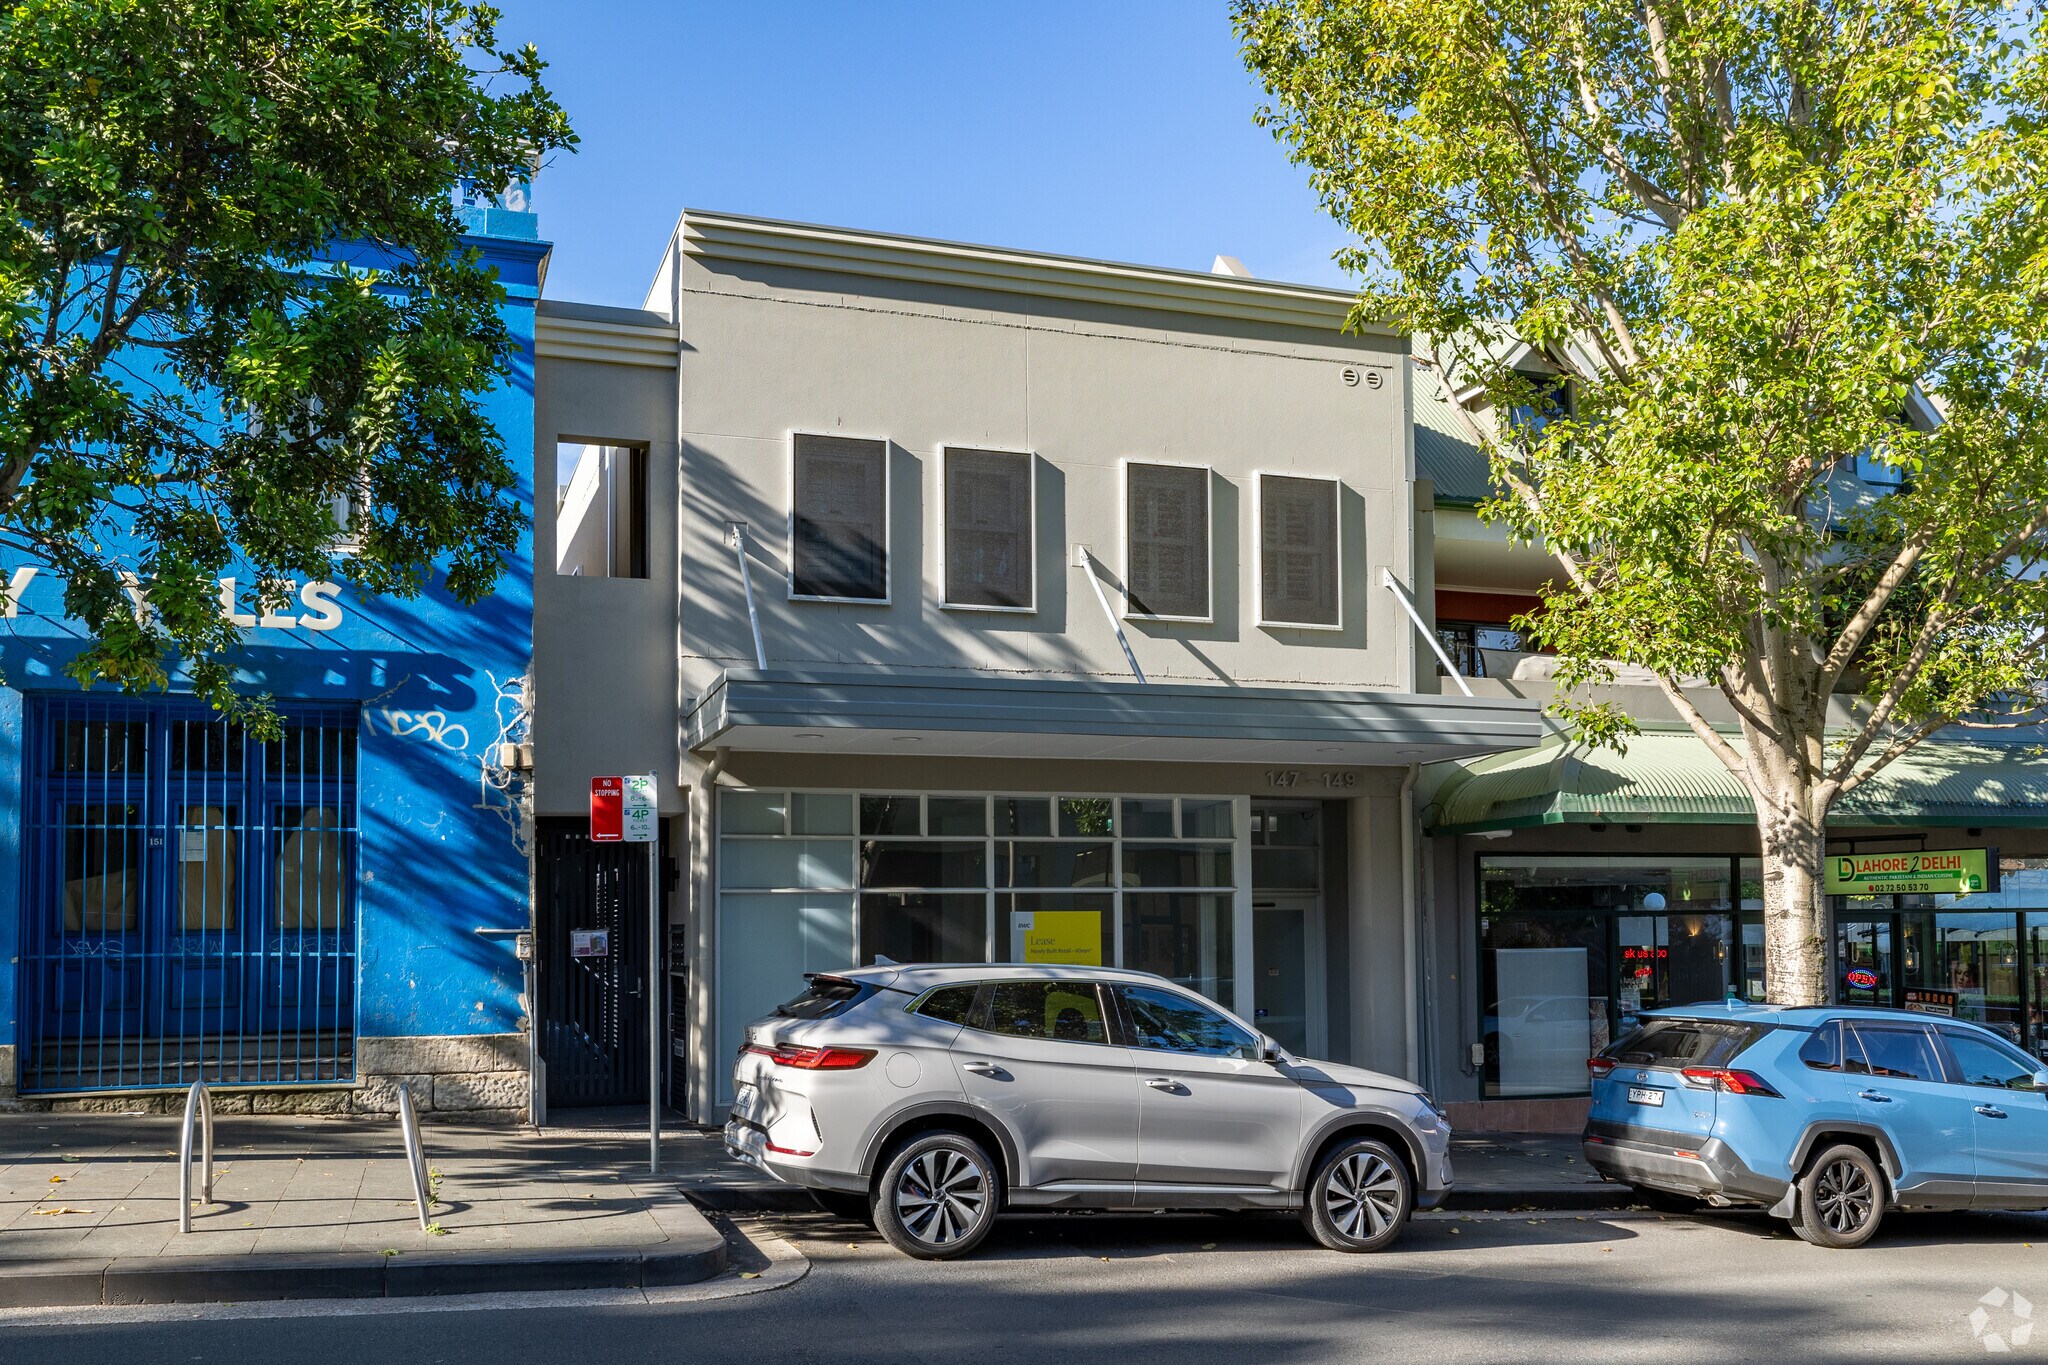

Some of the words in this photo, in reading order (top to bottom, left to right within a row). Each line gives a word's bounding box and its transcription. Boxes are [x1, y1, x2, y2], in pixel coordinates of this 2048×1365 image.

[1266, 770, 1300, 788] 147
[1322, 771, 1356, 788] 149
[632, 780, 648, 790] 2P
[595, 789, 620, 797] STOPPING
[632, 810, 649, 819] 4P
[149, 838, 163, 846] 151
[1856, 858, 1908, 873] LAHORE
[1908, 855, 1920, 873] 2
[1921, 855, 1961, 870] DELHI
[1875, 884, 1885, 892] 02
[1908, 883, 1917, 891] 53
[1919, 883, 1929, 891] 70
[1030, 936, 1056, 945] Lease
[1637, 950, 1649, 958] us
[1848, 972, 1878, 986] OPEN
